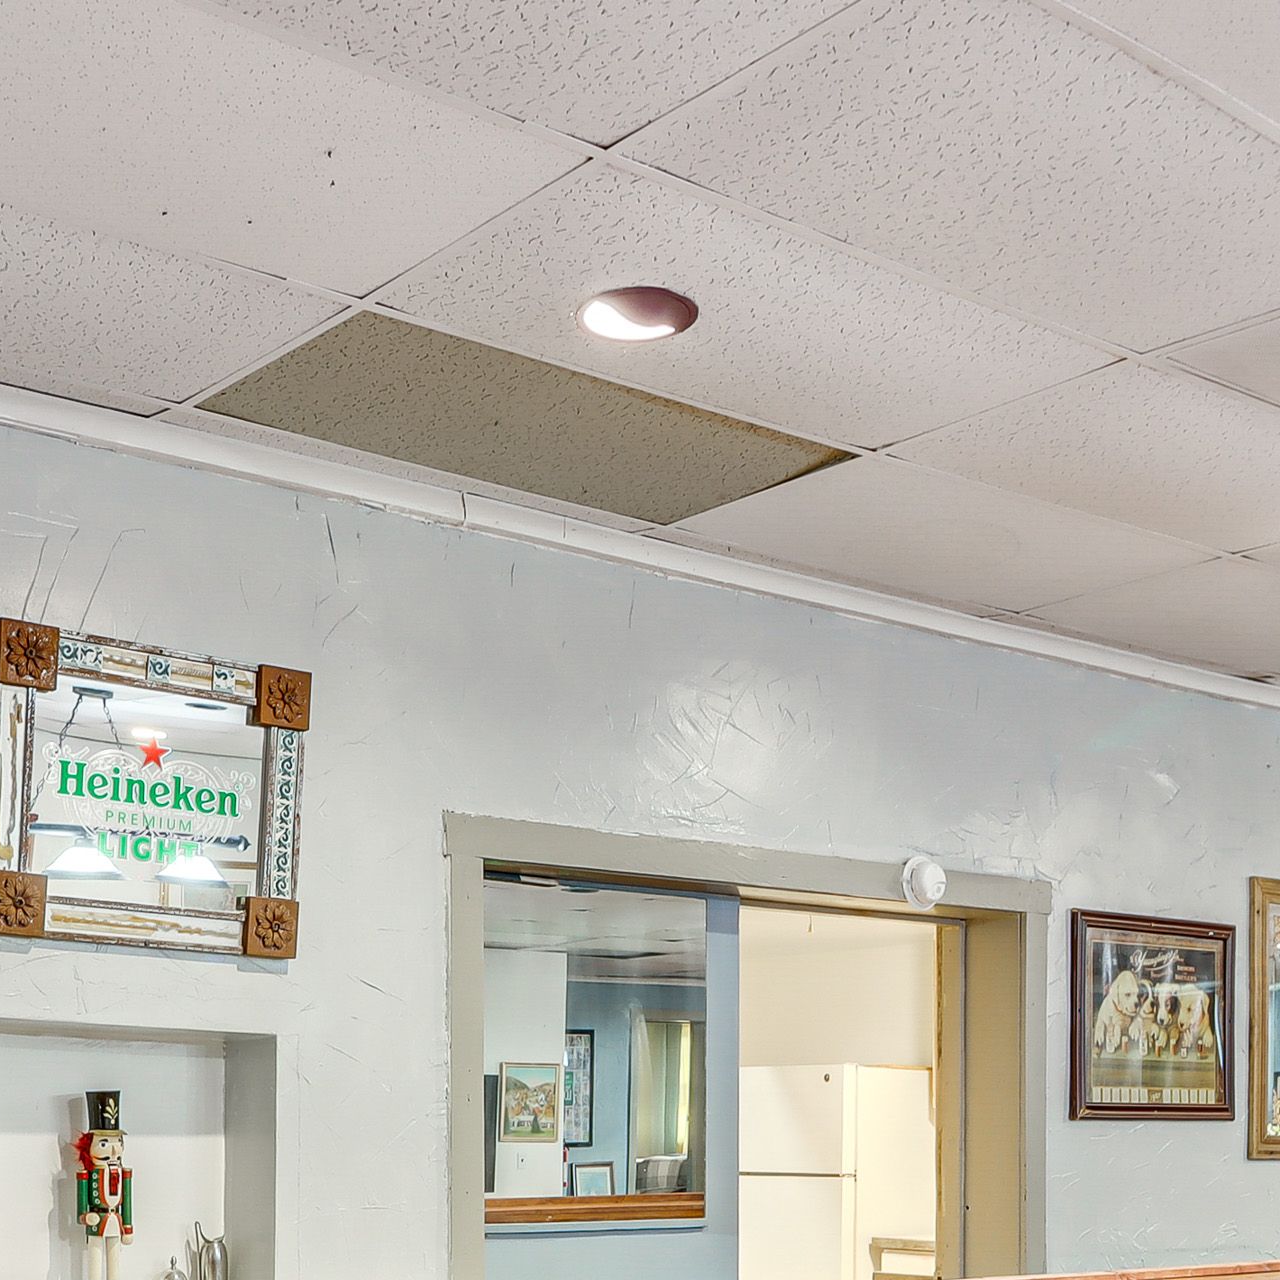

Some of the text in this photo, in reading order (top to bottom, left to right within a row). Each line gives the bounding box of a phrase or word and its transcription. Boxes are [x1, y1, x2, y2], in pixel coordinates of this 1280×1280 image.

[57, 759, 239, 818] Heineken
[105, 809, 192, 833] PREMIUM
[97, 831, 201, 865] LIGHT
